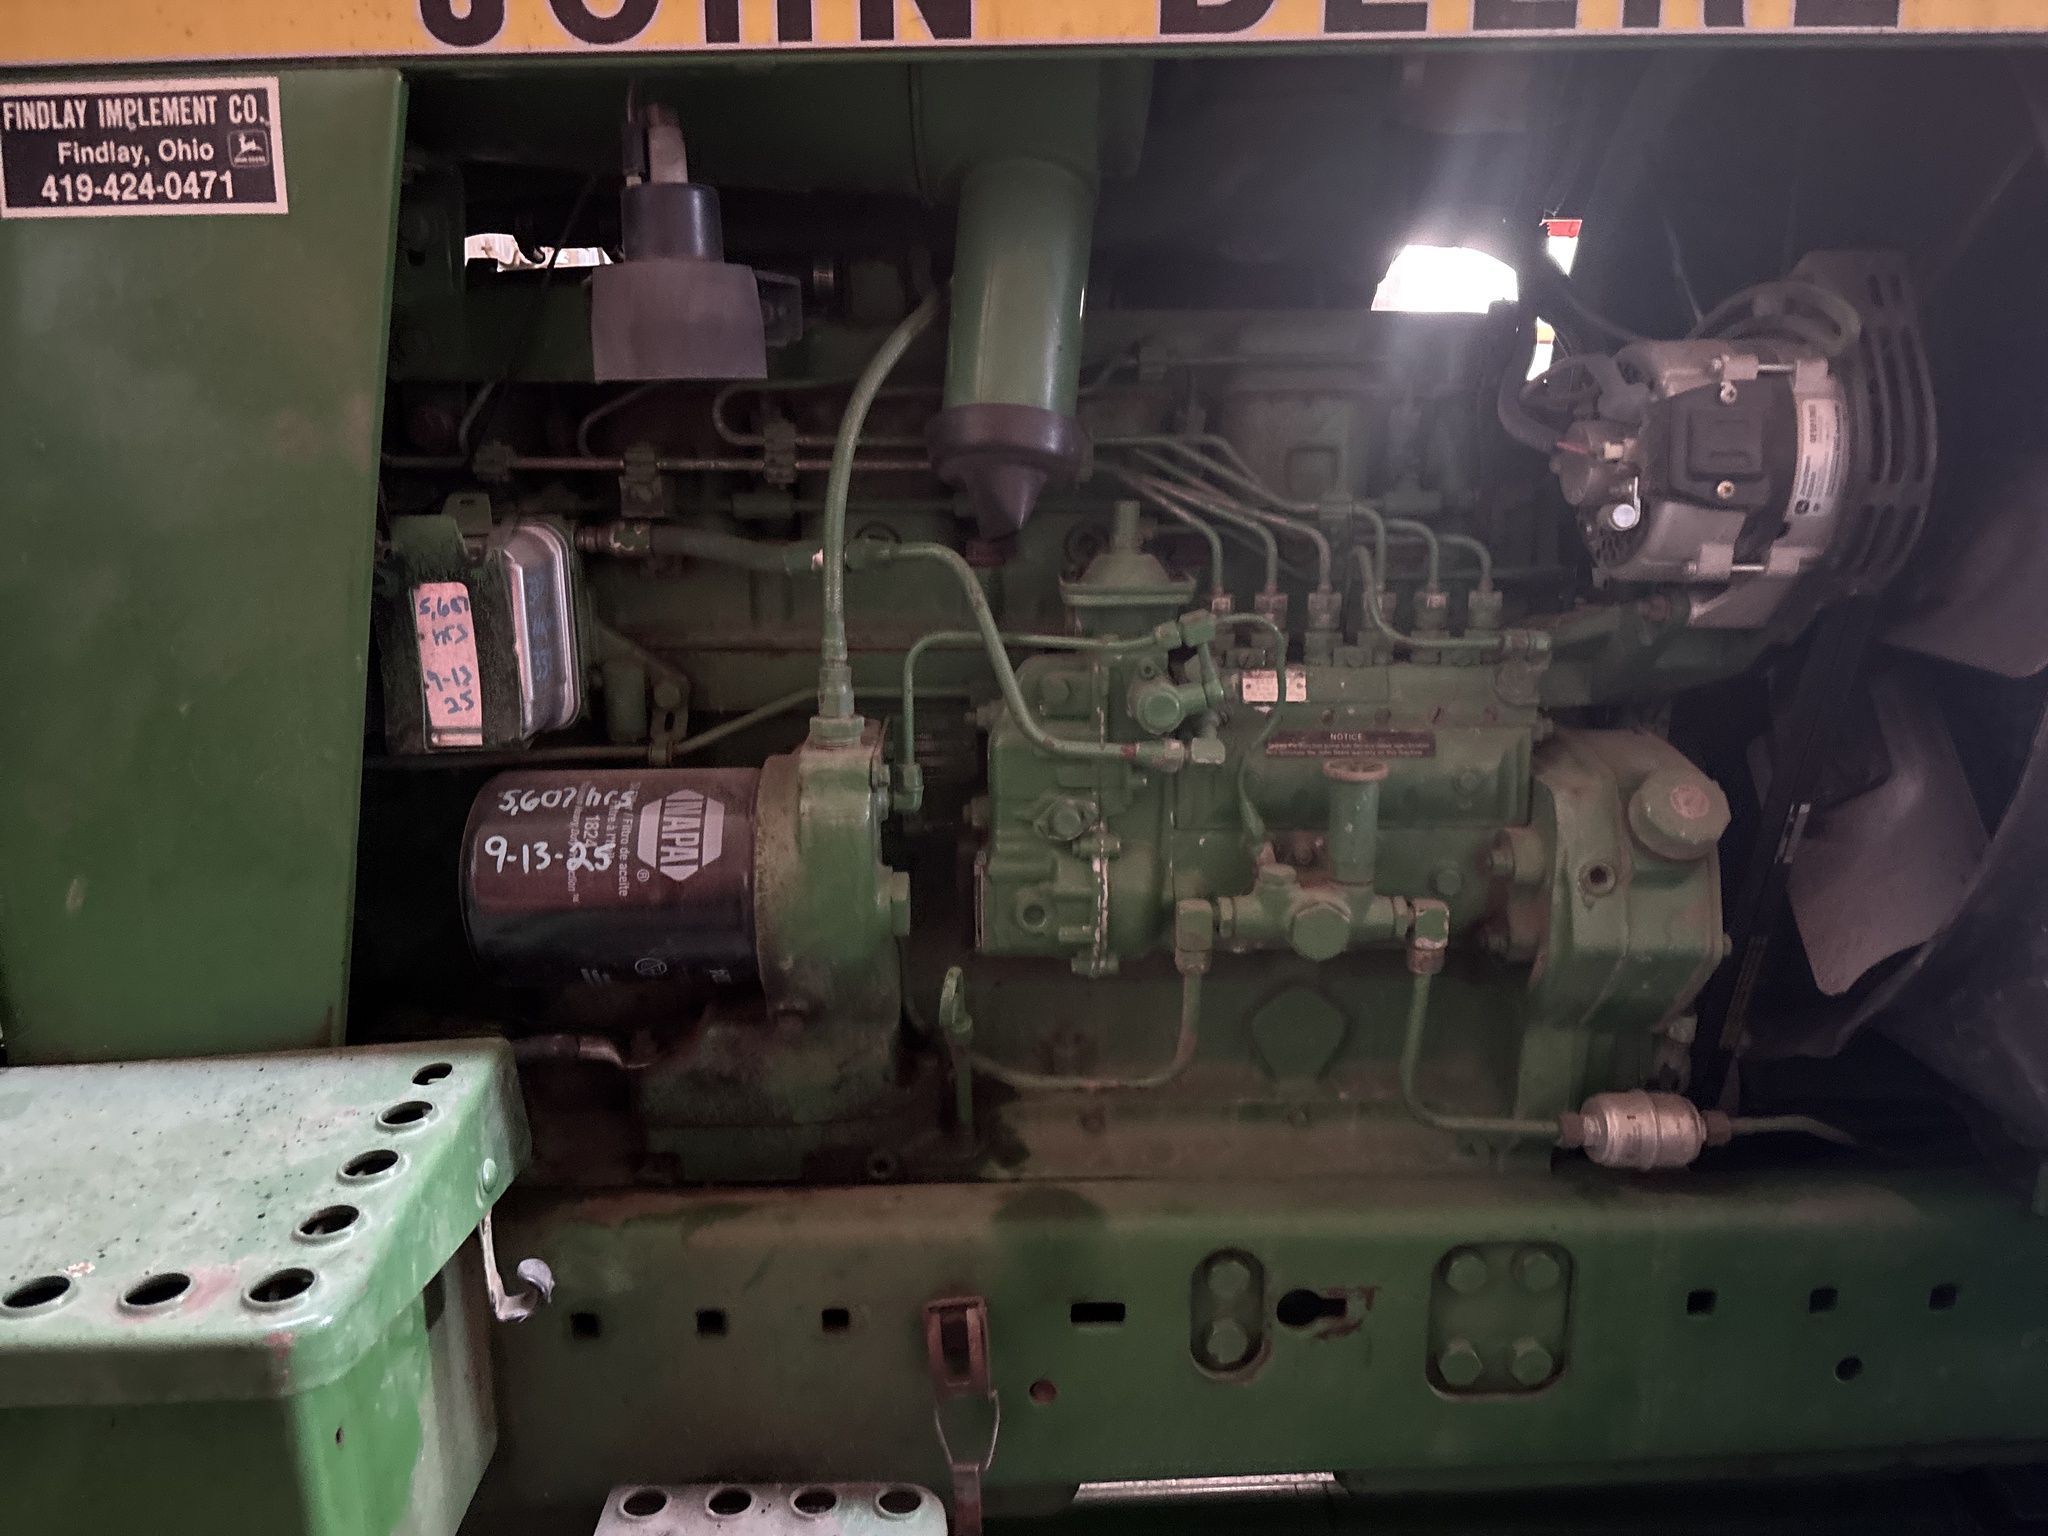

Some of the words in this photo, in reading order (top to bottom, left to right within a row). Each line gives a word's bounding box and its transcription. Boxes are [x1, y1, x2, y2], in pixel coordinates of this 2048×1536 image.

[3, 100, 87, 131] FINDLAY
[98, 95, 217, 131] IMPLEMENT
[57, 140, 150, 168] Findlay,
[158, 138, 214, 162] Ohio
[41, 170, 234, 203] 419-424-0471
[426, 665, 473, 692] 9-13
[444, 689, 475, 715] 25
[1330, 732, 1363, 741] NOTICE
[499, 787, 577, 816] 5,607
[585, 786, 635, 810] hrs
[583, 814, 601, 848] 1824
[620, 818, 634, 845] Filtro
[660, 800, 703, 865] NAPA
[484, 835, 616, 874] 9-13-25
[619, 846, 631, 861] de
[618, 863, 631, 897] aceite
